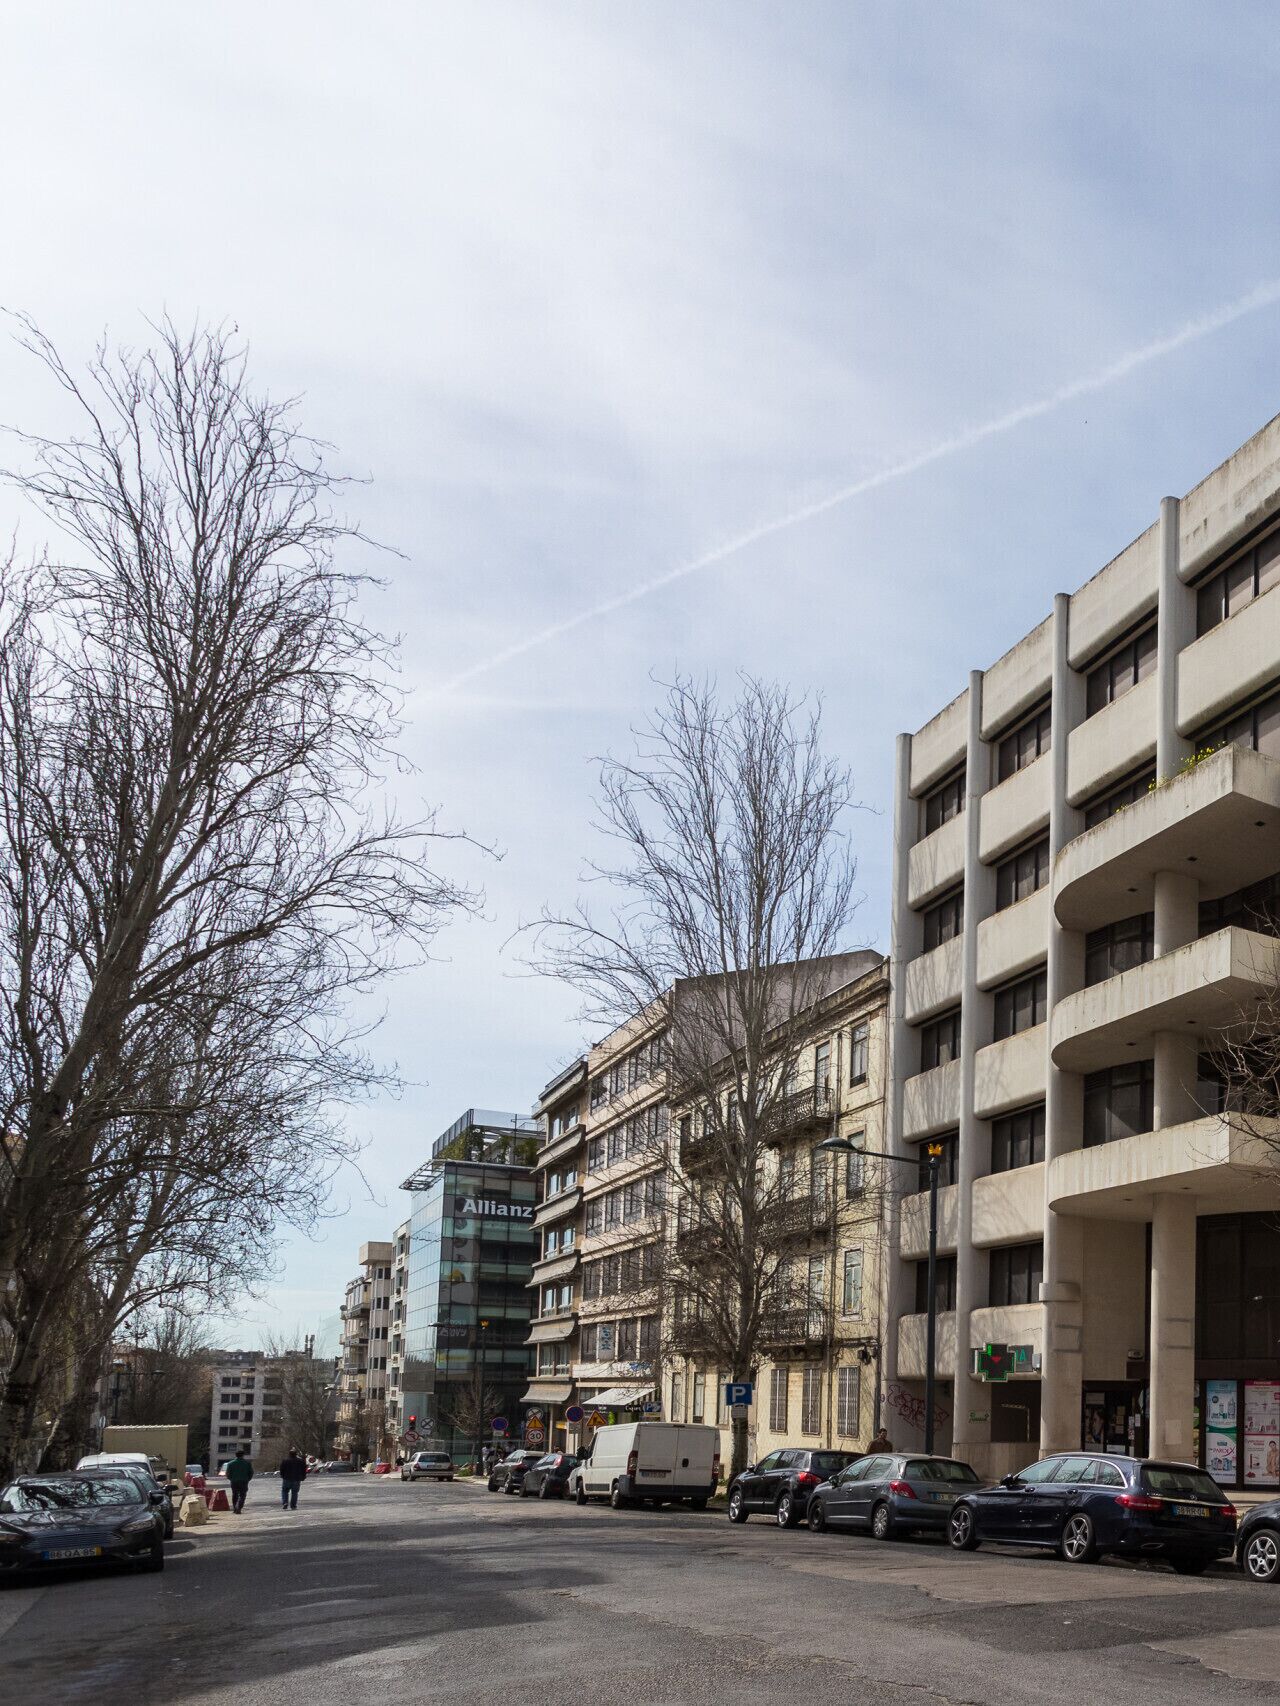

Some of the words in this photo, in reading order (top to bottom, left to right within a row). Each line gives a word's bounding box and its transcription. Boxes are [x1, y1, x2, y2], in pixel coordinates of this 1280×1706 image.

[462, 1199, 533, 1218] Allianz
[732, 1386, 745, 1402] P
[530, 1432, 541, 1440] 30
